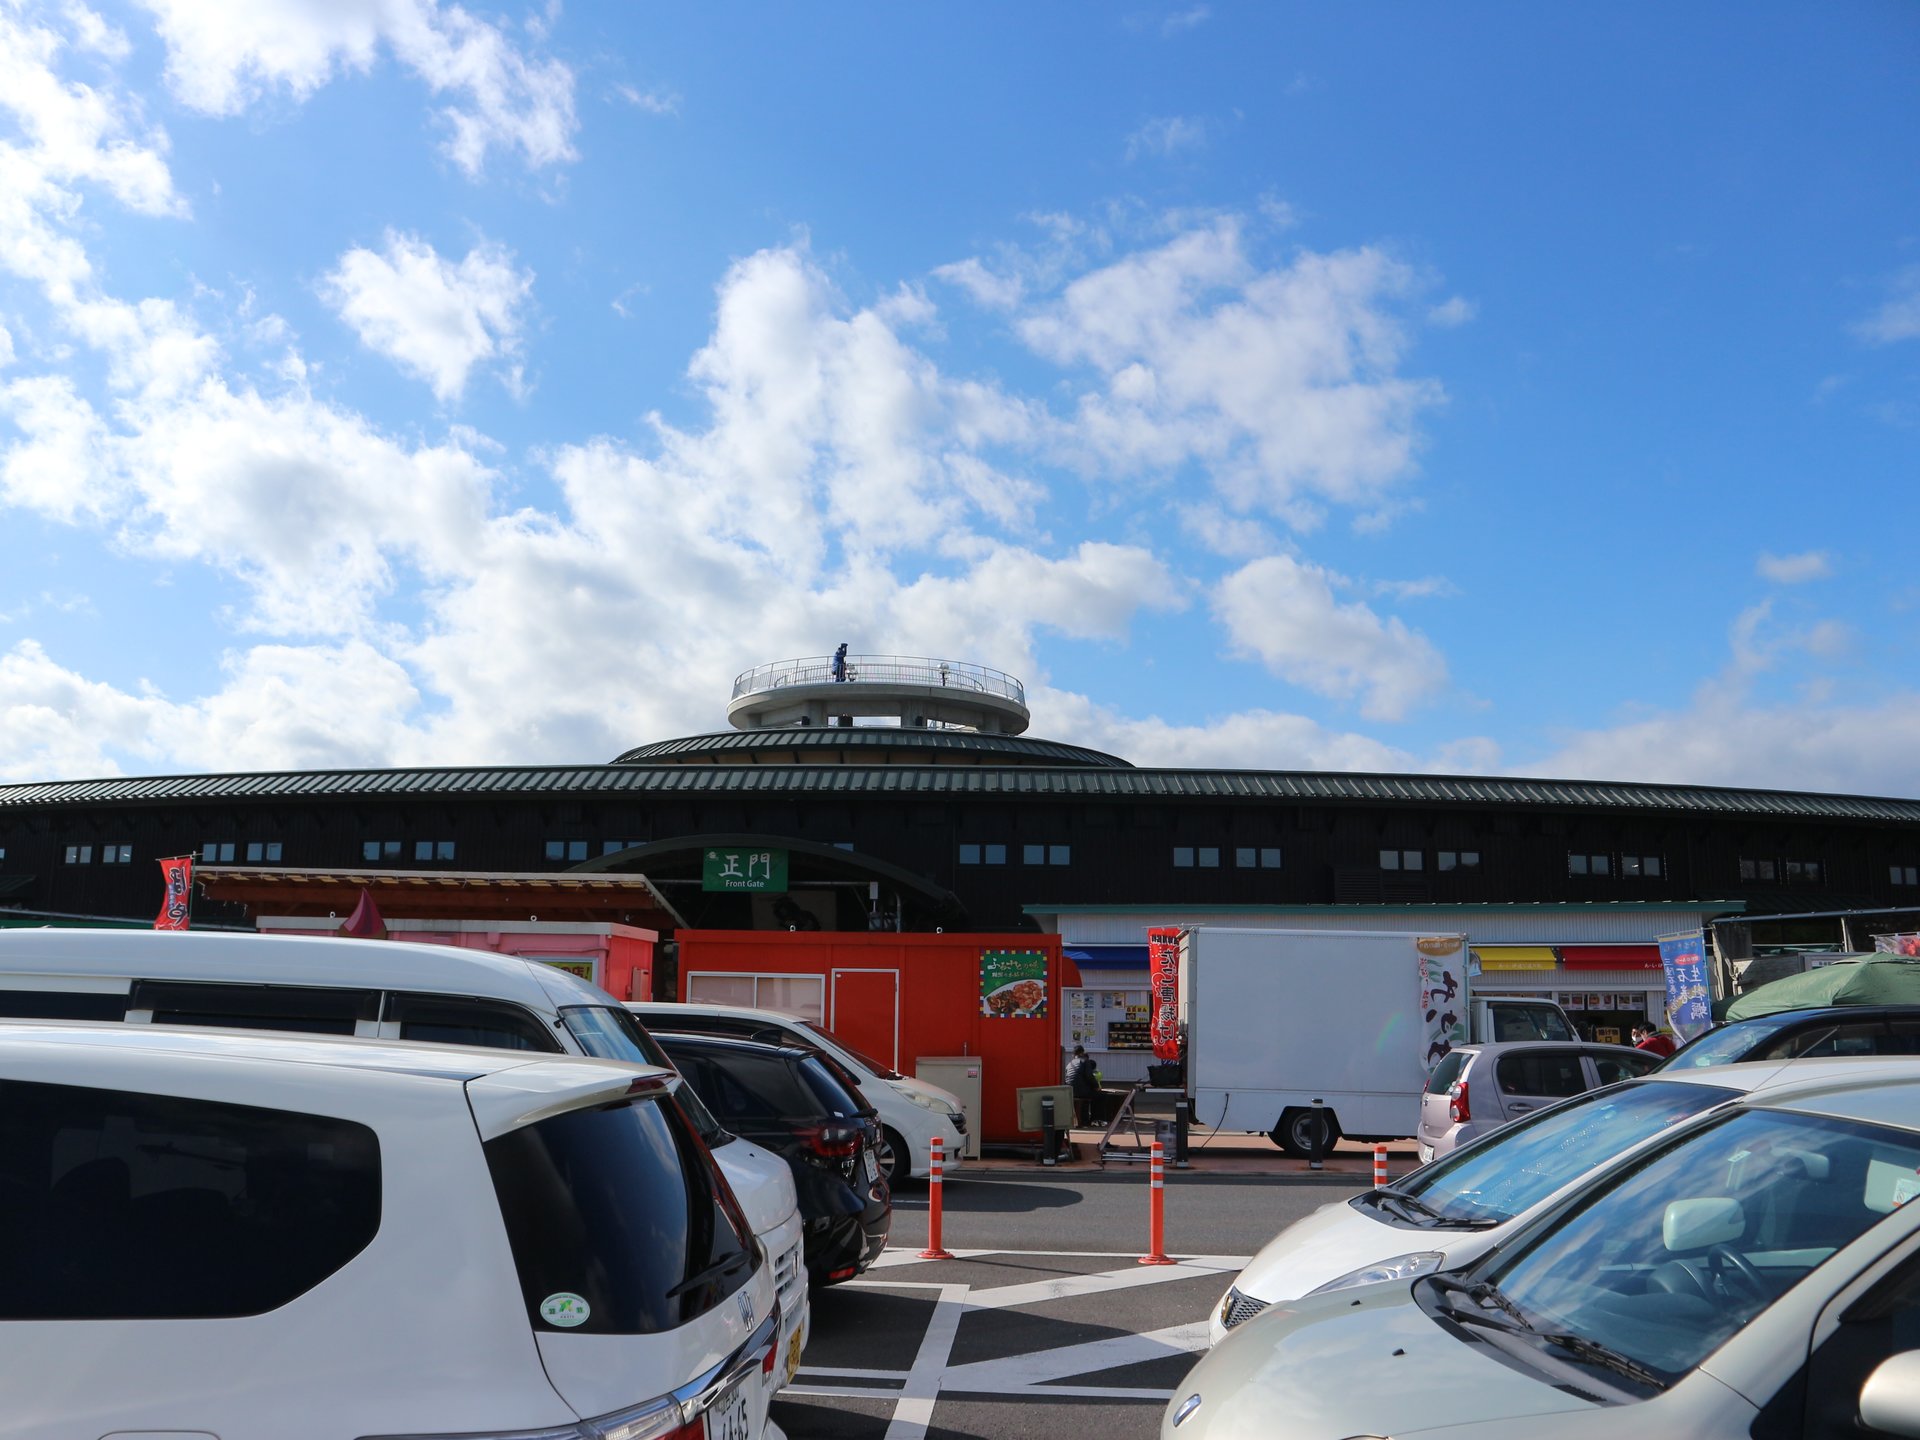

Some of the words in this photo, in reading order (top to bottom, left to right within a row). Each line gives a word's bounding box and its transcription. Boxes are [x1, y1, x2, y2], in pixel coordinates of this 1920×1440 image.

[718, 853, 771, 879] 正門
[725, 879, 745, 888] Front
[747, 879, 765, 888] Gate
